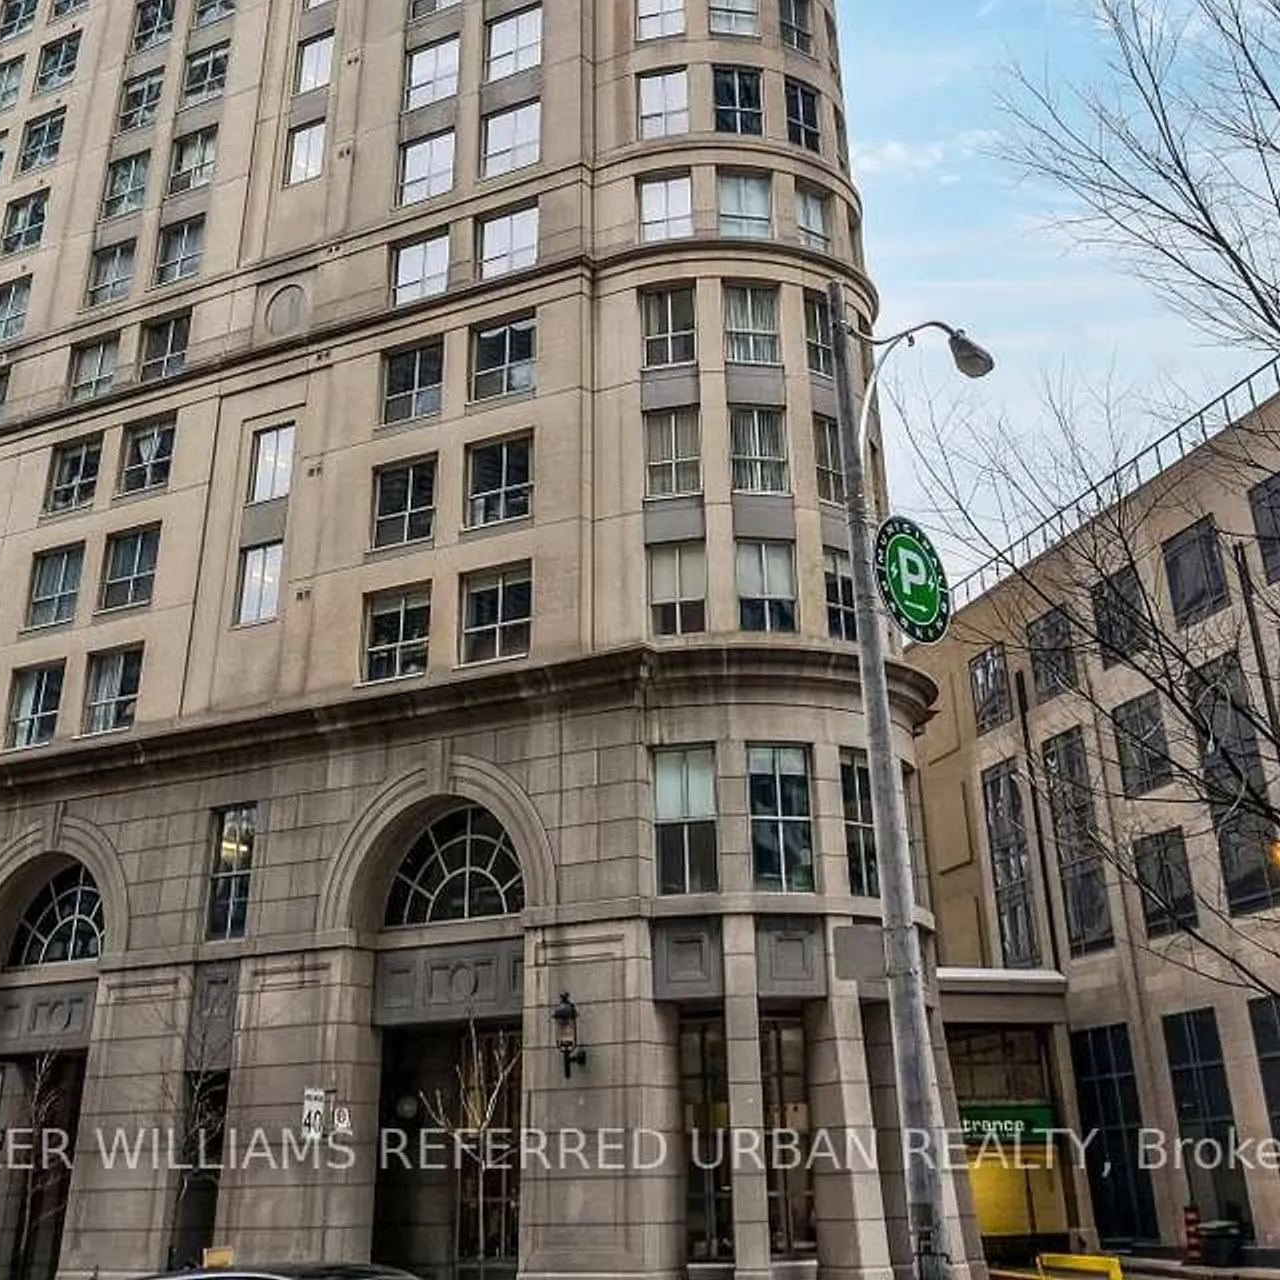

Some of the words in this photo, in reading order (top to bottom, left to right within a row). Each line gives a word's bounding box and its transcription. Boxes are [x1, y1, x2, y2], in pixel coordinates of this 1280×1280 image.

[877, 523, 946, 587] MUNICIPAL
[898, 546, 927, 596] P
[882, 580, 948, 639] PARKING
